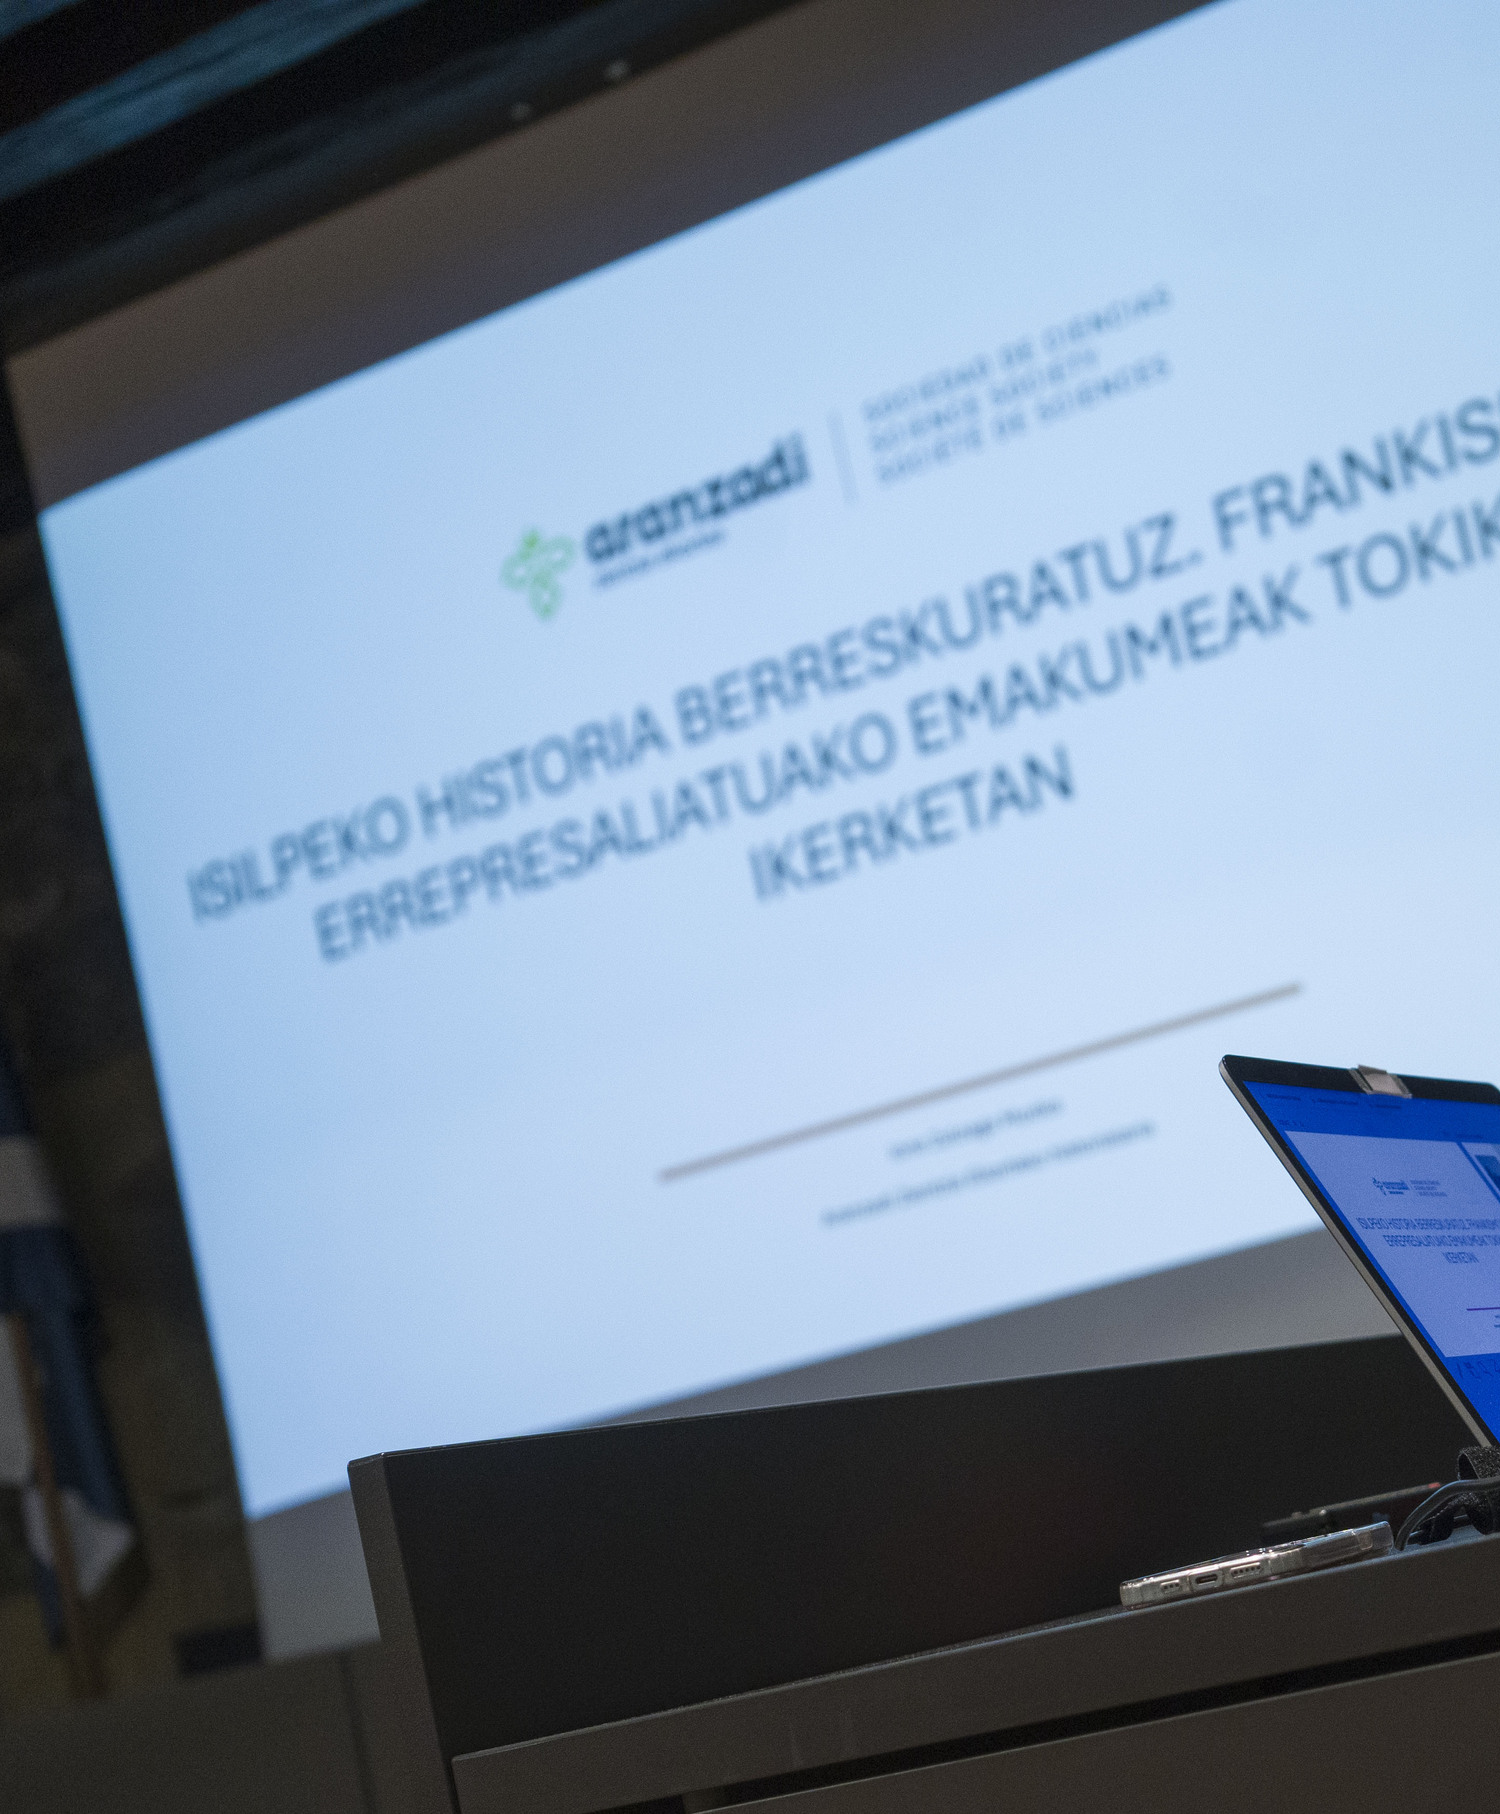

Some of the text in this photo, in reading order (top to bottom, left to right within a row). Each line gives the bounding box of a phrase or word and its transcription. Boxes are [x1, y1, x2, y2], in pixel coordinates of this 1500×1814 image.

[585, 431, 810, 566] aranzadi
[185, 792, 408, 921] ISILPEKO
[414, 702, 672, 839] HISTORIA
[672, 510, 1203, 749] BERRESKURATUZ.
[312, 709, 898, 964] ERREPRESALIATUAKO
[904, 561, 1311, 759] EMAKUMEAK
[746, 740, 1080, 903] IKERKETAN
